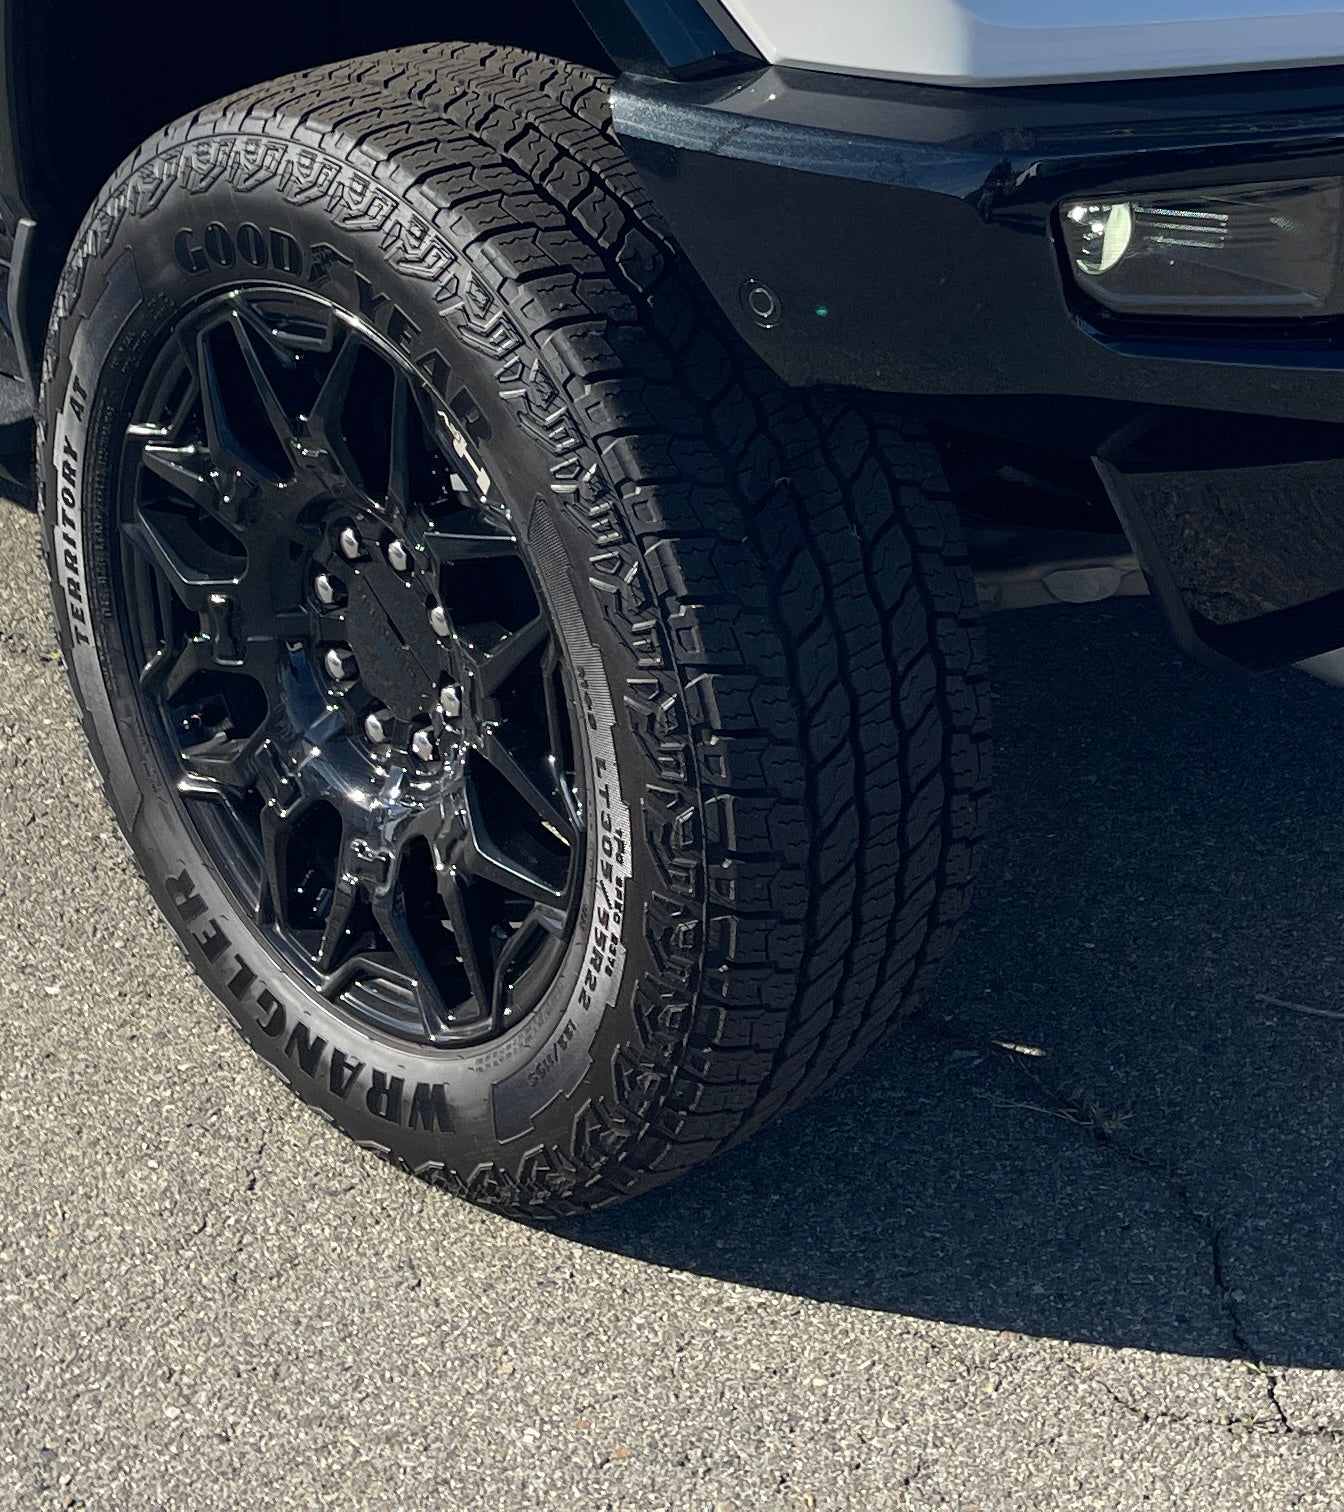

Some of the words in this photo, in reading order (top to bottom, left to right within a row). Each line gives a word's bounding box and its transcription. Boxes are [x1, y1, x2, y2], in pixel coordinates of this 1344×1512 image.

[68, 374, 89, 423] AT
[173, 220, 493, 450] GOODYEAR
[60, 434, 90, 646] TERRITORY
[577, 754, 613, 1012] LT305/55R22
[164, 867, 457, 1134] WRANGLER
